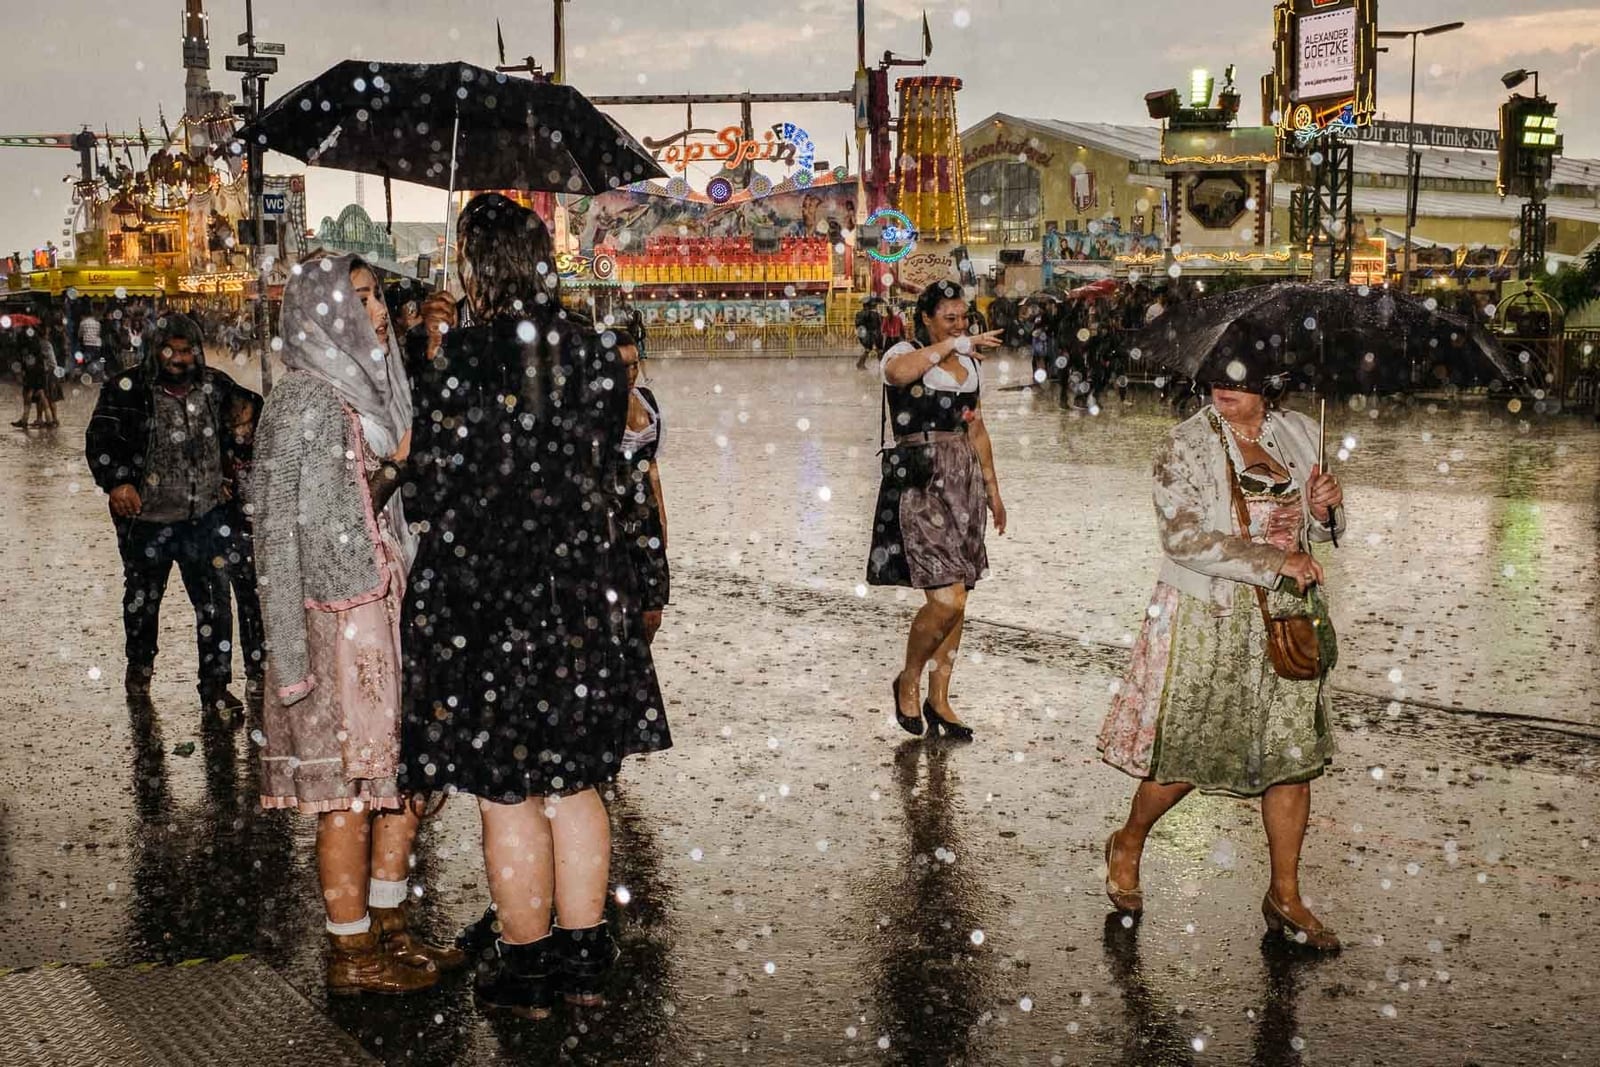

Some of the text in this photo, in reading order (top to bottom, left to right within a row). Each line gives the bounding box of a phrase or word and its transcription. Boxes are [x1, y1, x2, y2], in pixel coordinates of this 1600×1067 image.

[1305, 28, 1348, 45] ALEXANDER
[1305, 39, 1348, 59] GOETZKE
[1362, 122, 1386, 141] Dir
[1431, 127, 1469, 147] trinke
[1472, 130, 1499, 150] SPA
[643, 126, 796, 172] Top Spin
[265, 198, 284, 210] WC
[666, 306, 716, 324] SPIN
[723, 305, 787, 323] FRESH
